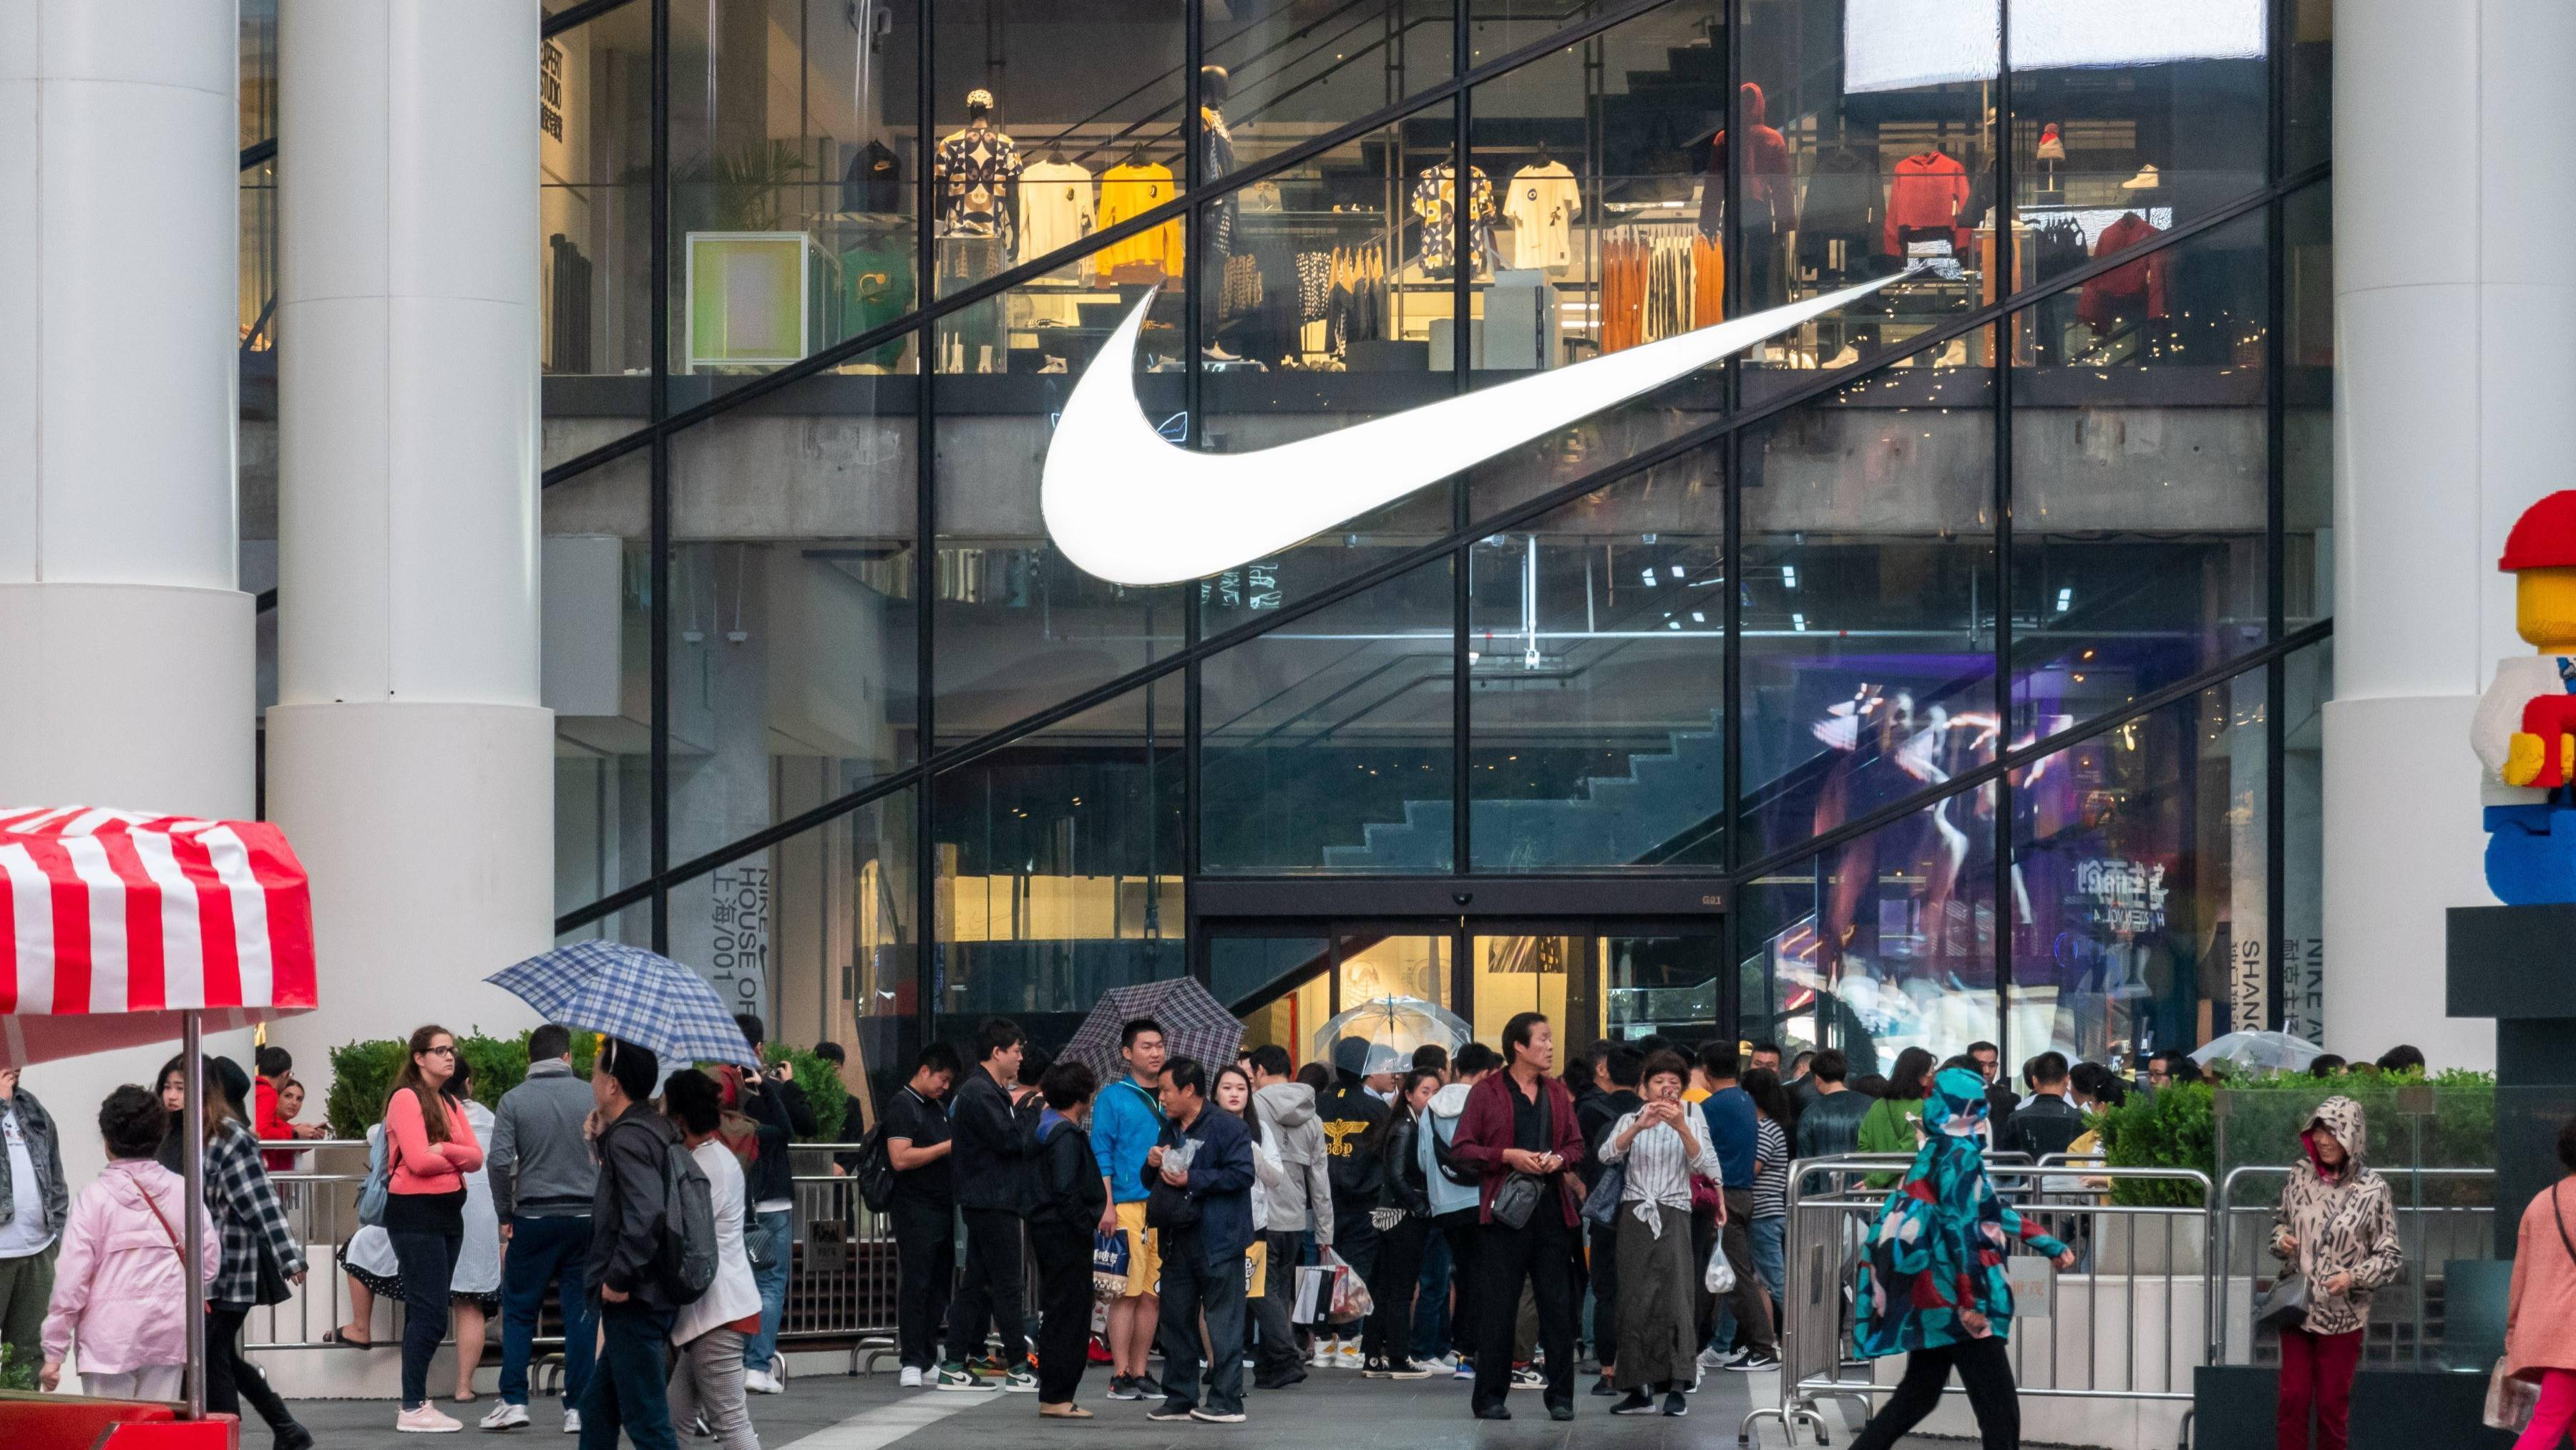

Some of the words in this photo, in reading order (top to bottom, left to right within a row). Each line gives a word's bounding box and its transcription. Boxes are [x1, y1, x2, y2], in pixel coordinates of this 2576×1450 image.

[712, 870, 737, 981] 上海/001
[738, 867, 757, 968] HOUSE
[758, 868, 768, 933] NIKE
[738, 978, 757, 1016] OF
[2307, 938, 2323, 1009] NIKE
